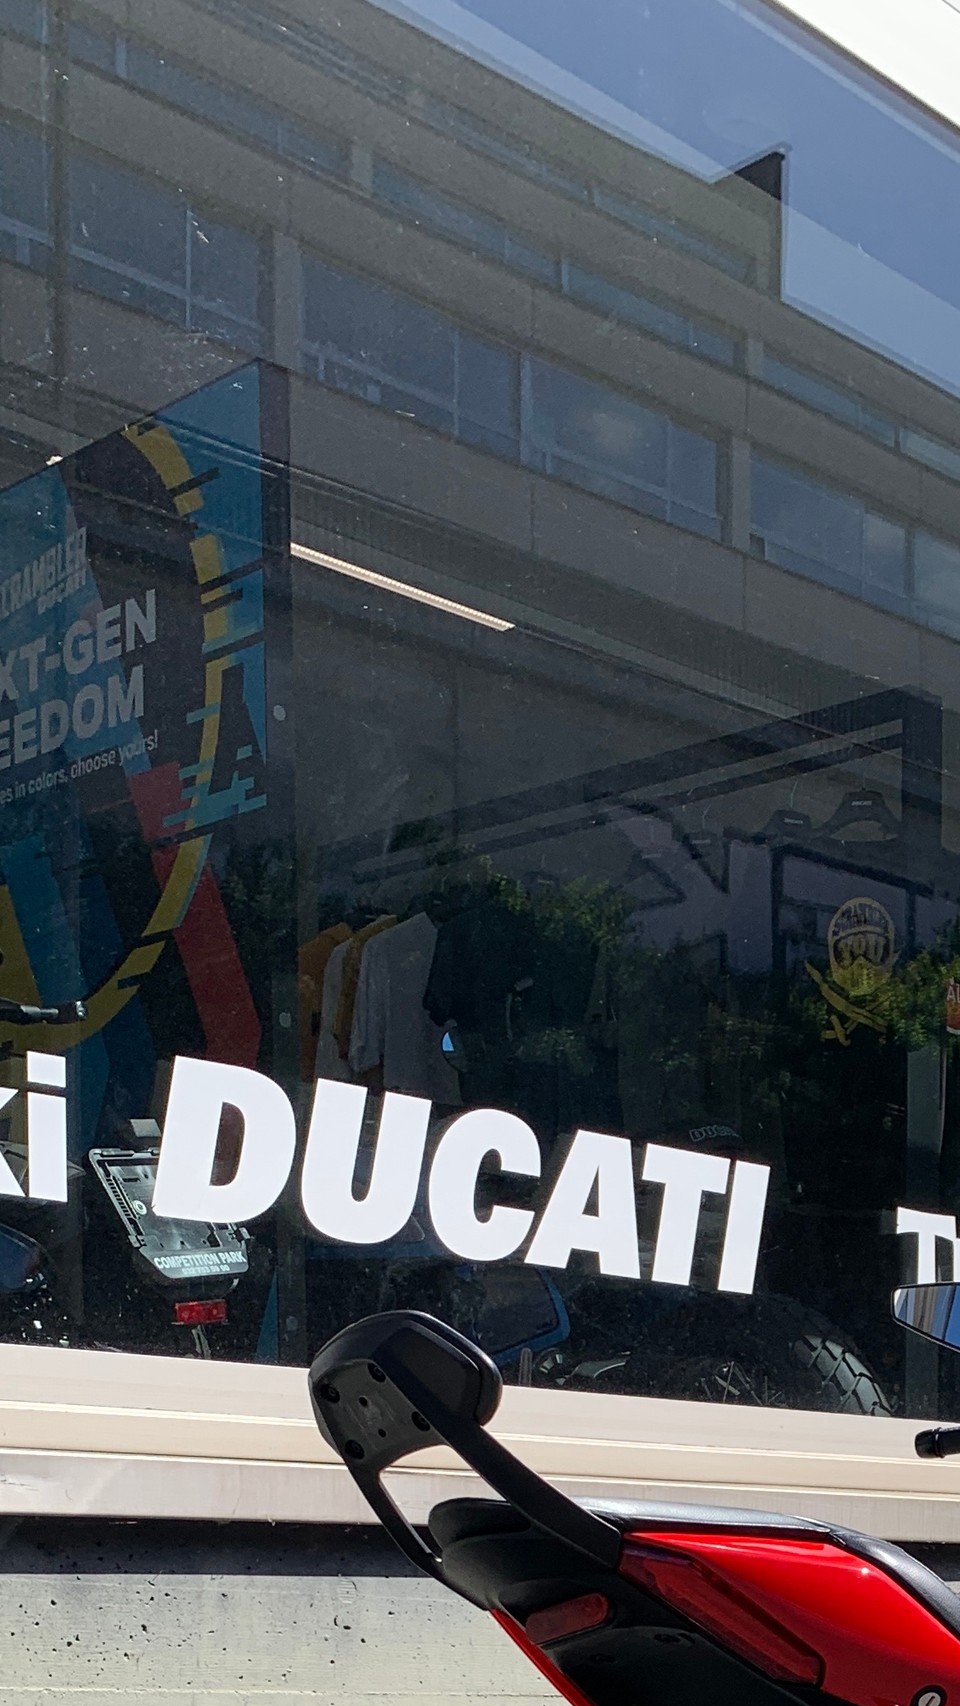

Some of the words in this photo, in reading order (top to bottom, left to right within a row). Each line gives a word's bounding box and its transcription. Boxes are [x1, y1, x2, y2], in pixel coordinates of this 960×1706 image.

[152, 1055, 771, 1295] DUCATI
[154, 1254, 220, 1269] COMPETITION
[218, 1251, 246, 1264] PARK
